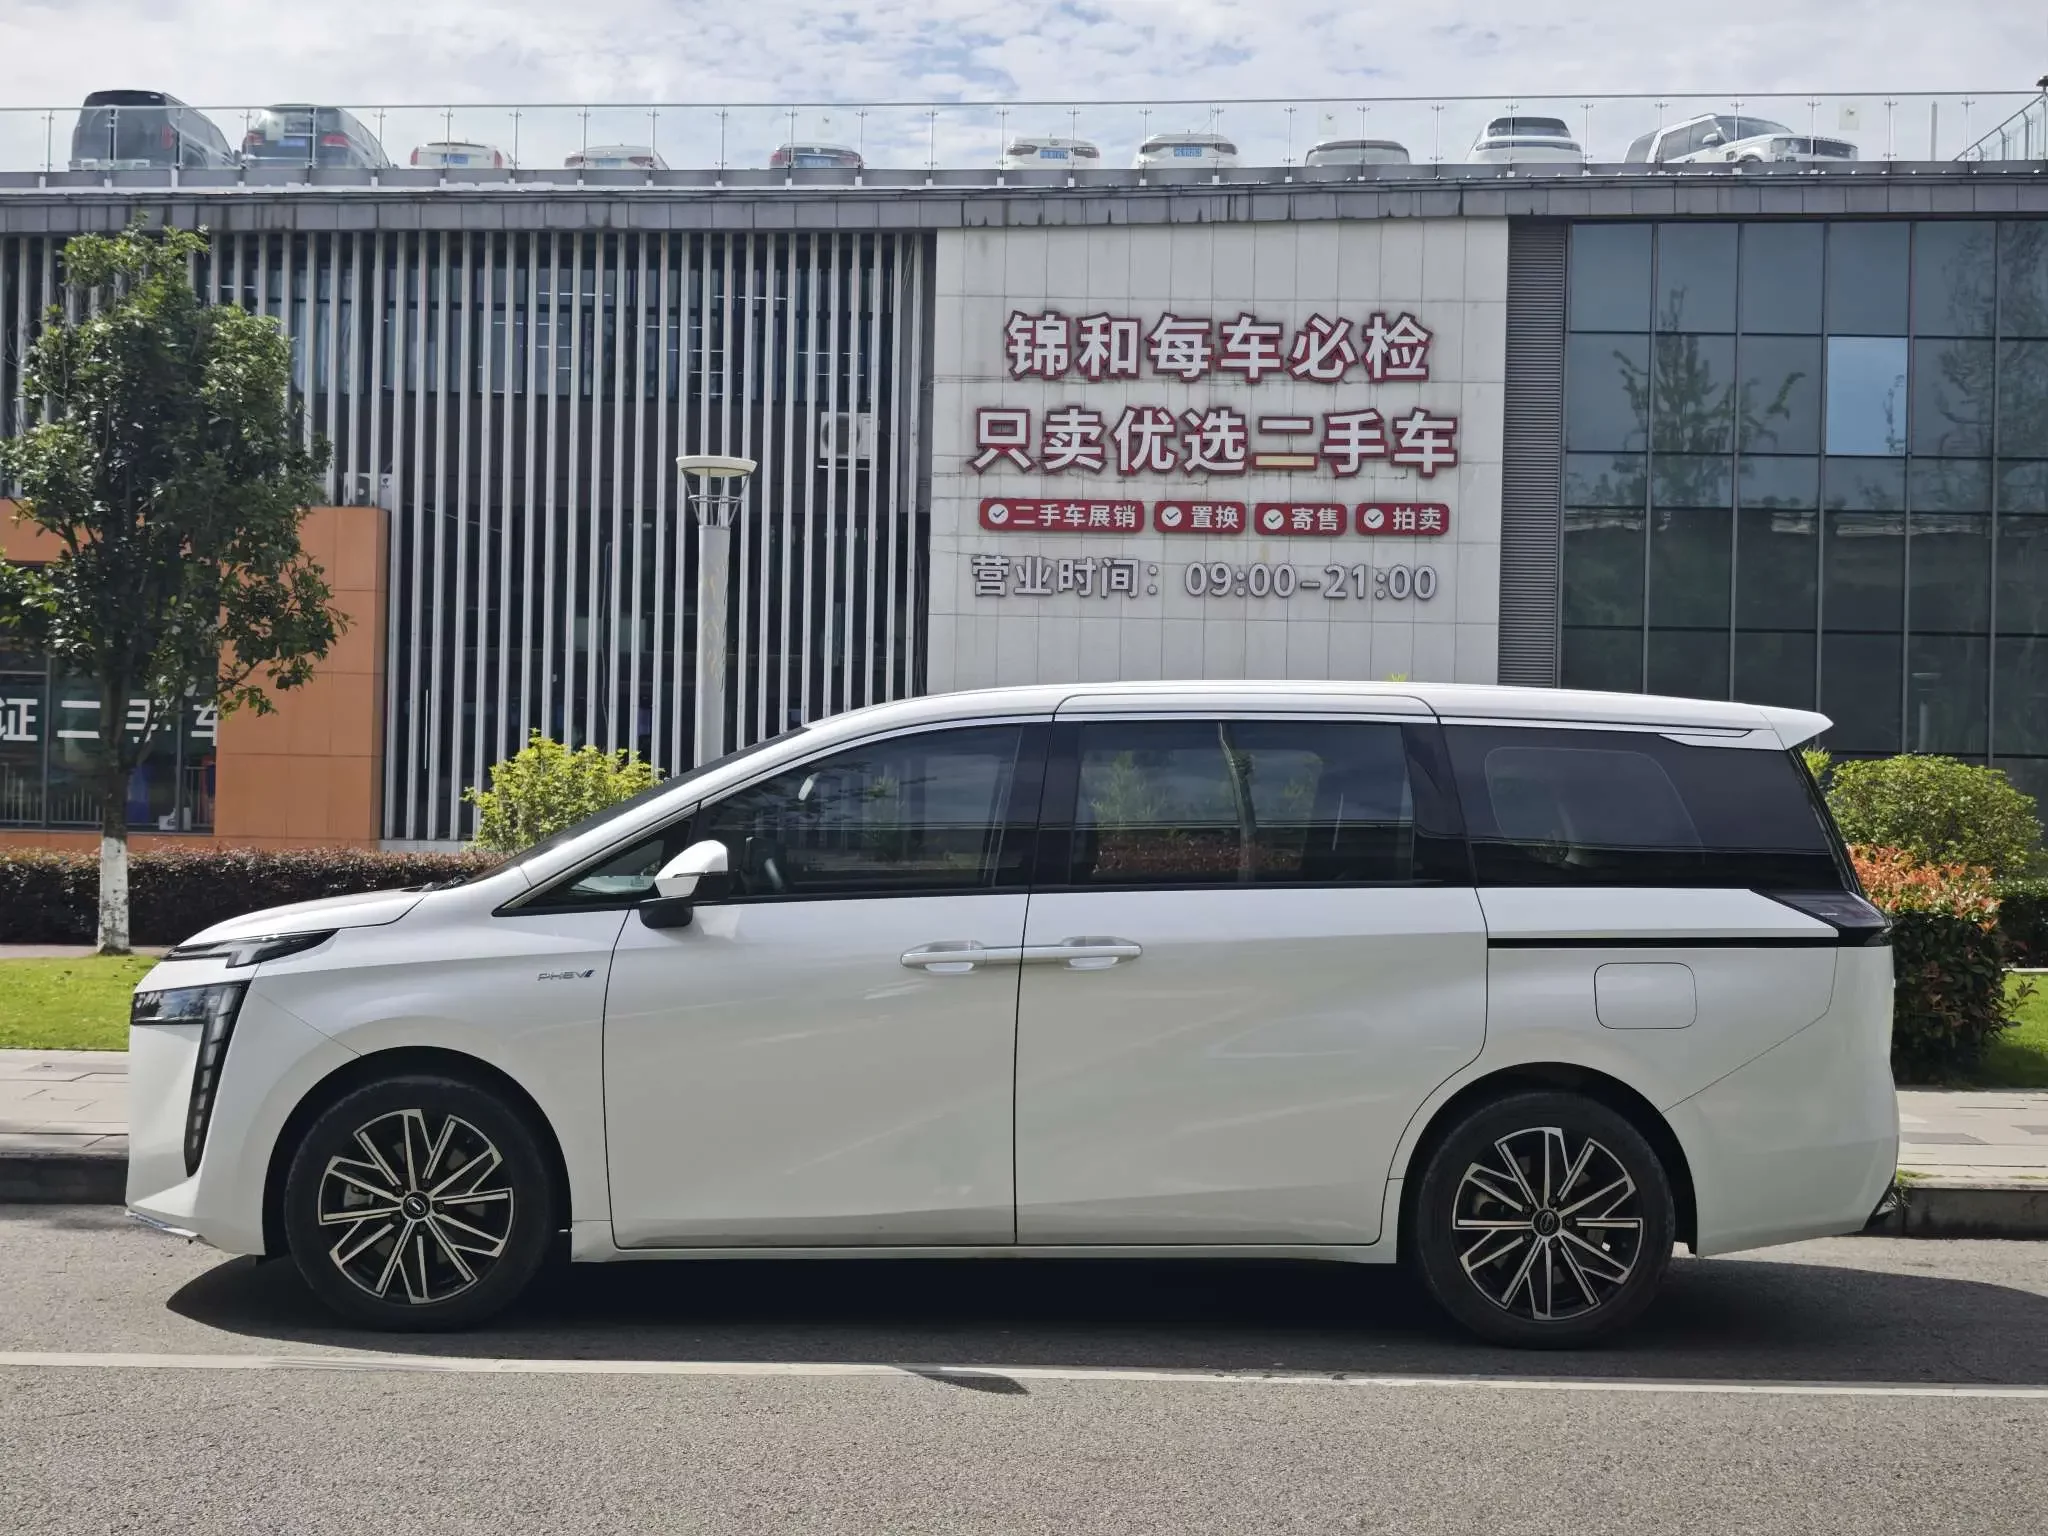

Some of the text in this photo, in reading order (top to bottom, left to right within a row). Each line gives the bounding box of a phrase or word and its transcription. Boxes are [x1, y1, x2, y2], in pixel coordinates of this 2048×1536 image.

[1005, 311, 1434, 382] 锦和每车必检
[970, 404, 1459, 477] 只卖优选二手车
[1013, 503, 1137, 529] 二手车展销
[1190, 505, 1240, 530] 置换
[1291, 508, 1339, 532] 寄售
[1392, 508, 1442, 532] 拍卖
